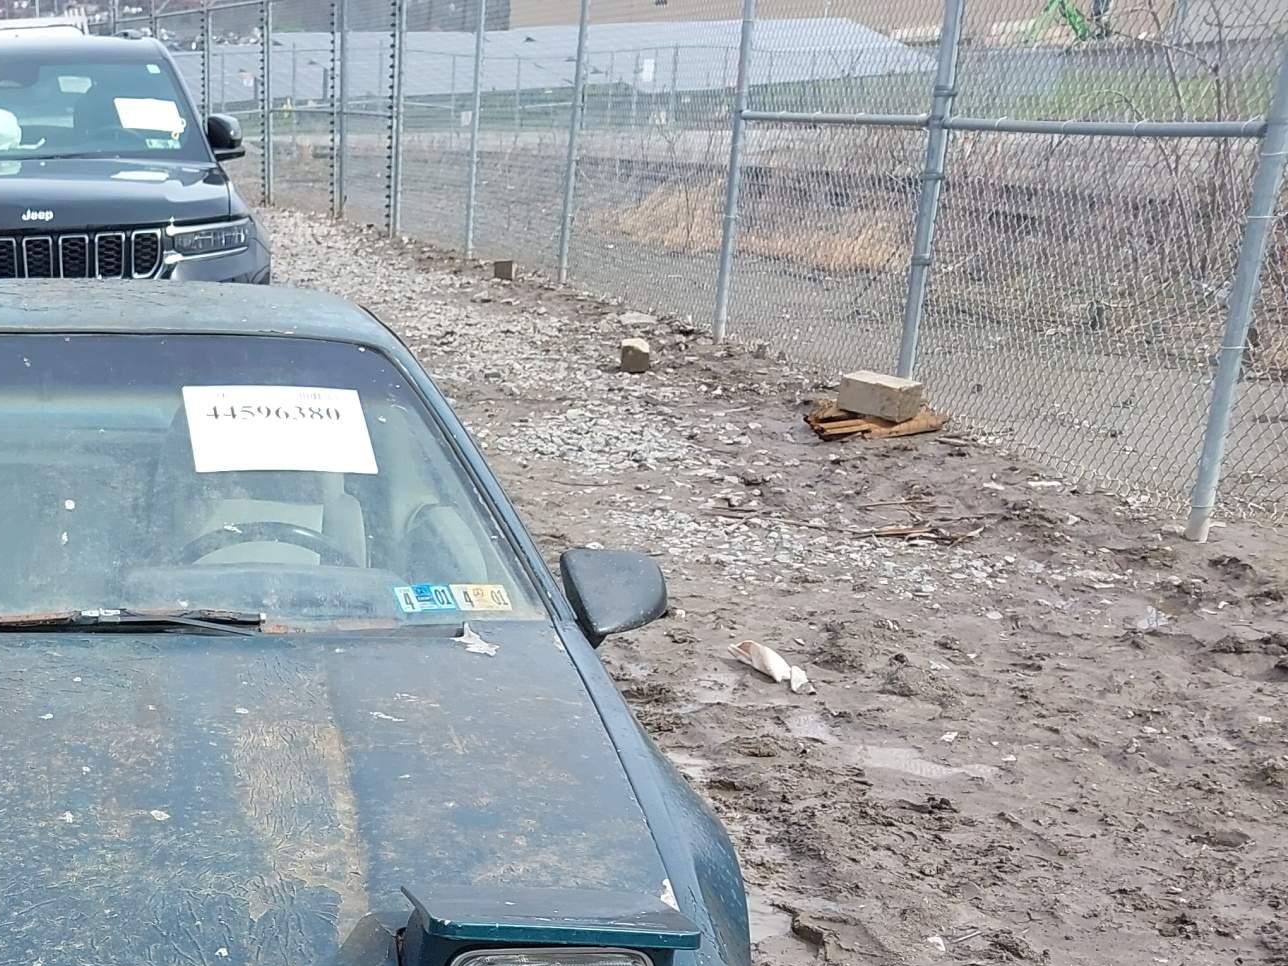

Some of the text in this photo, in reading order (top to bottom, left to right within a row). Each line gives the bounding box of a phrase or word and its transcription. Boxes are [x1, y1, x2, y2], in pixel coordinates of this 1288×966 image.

[21, 208, 54, 221] Jeep
[206, 405, 341, 421] 44596380
[403, 592, 416, 610] 4
[434, 588, 452, 606] 01
[462, 590, 475, 608] 4
[490, 590, 509, 606] 01
